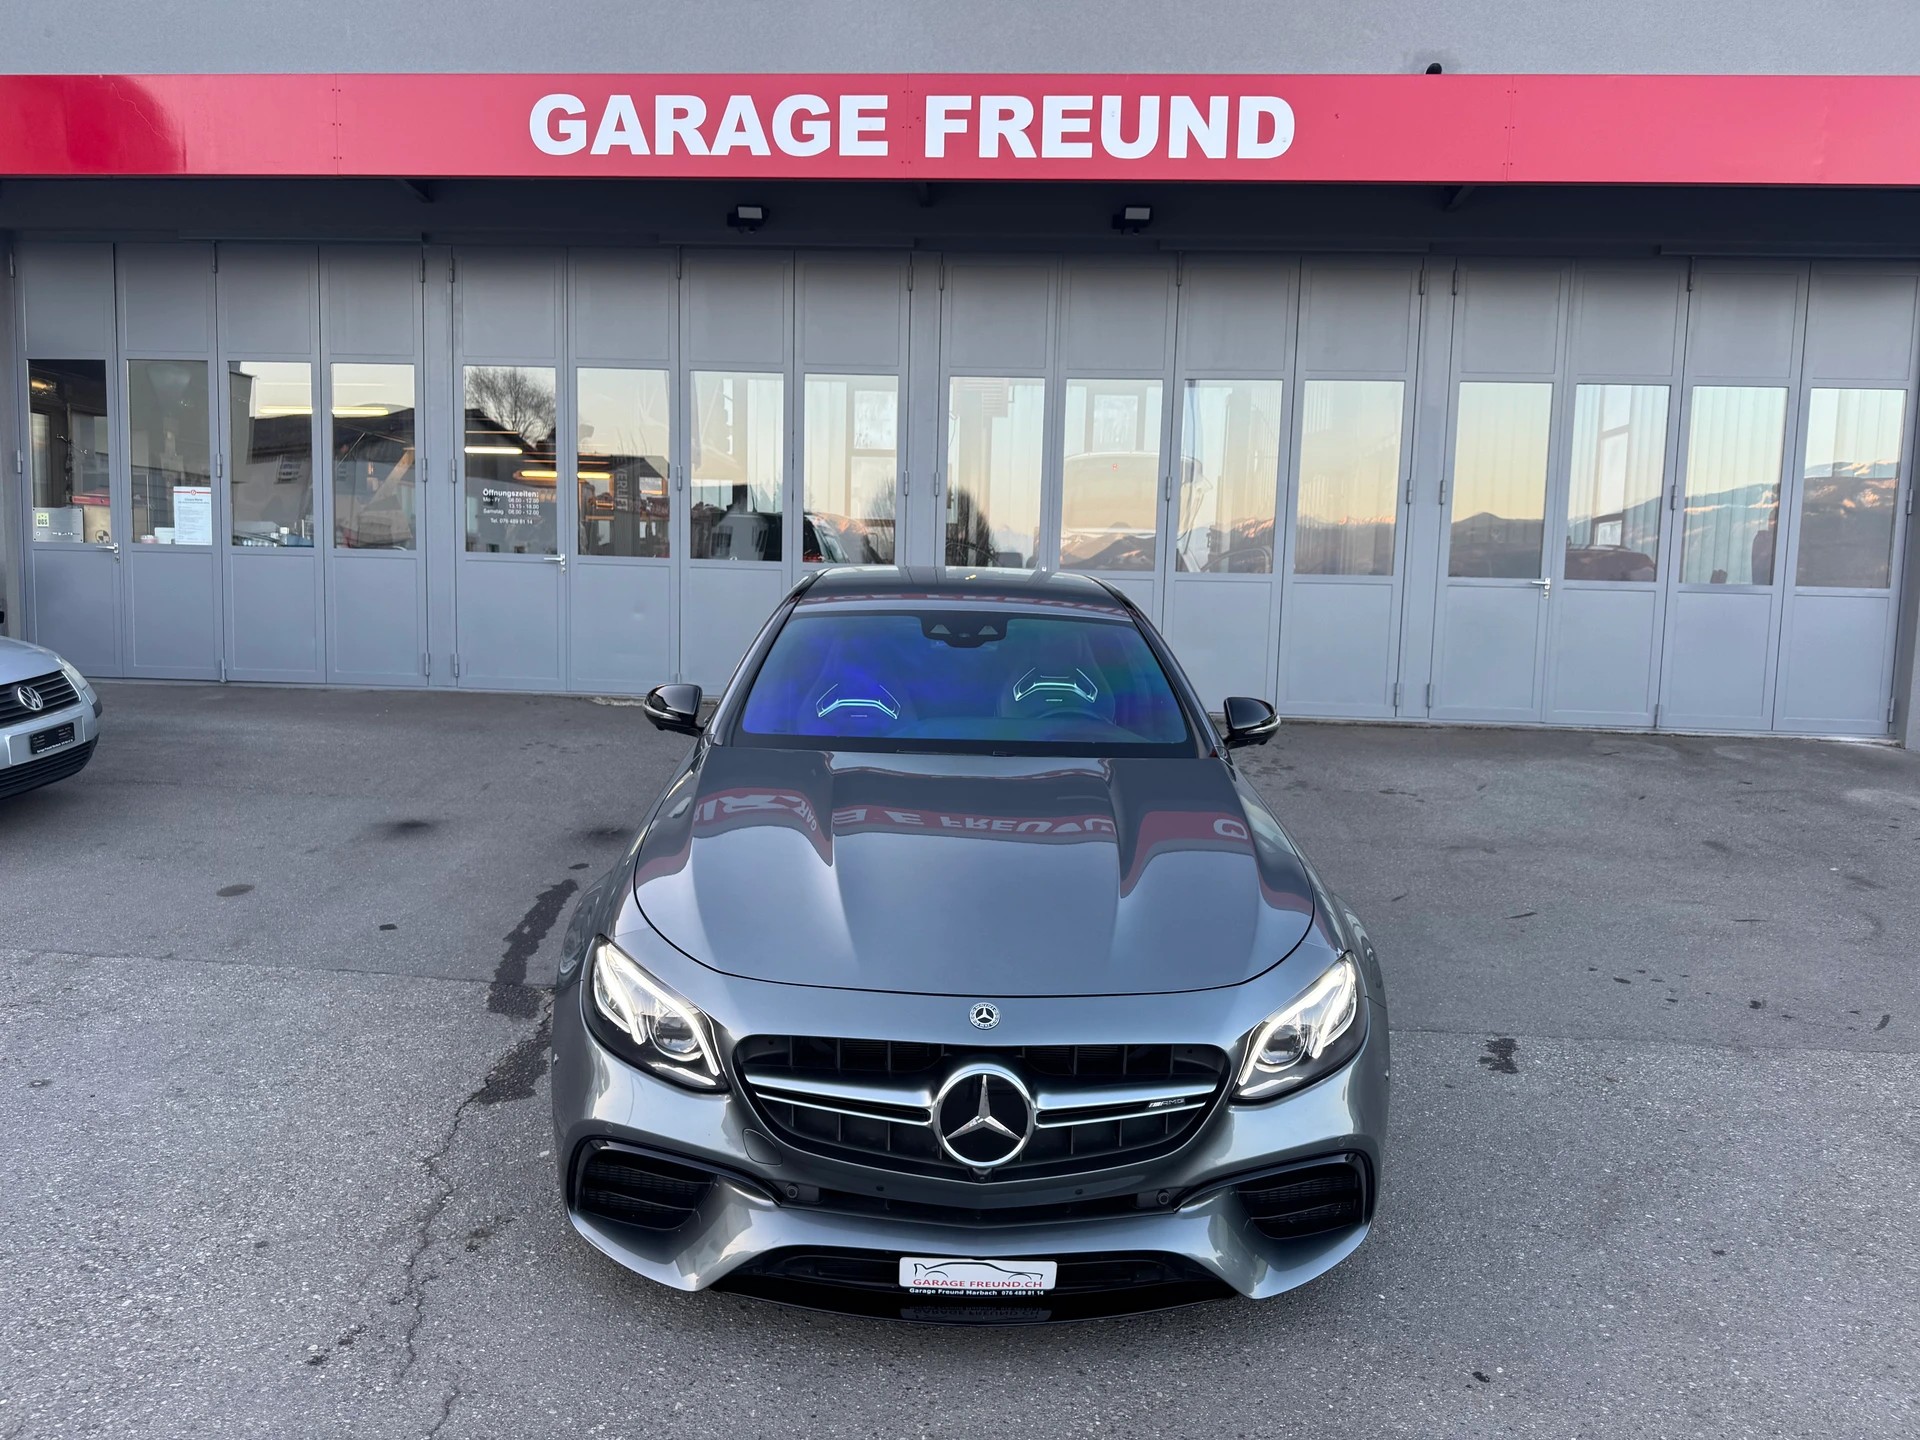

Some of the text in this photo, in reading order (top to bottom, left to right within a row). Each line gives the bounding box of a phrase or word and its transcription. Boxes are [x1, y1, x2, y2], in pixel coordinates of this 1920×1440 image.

[529, 93, 1295, 160] GARAGE FREUND
[483, 488, 539, 498] Öffnungszeiten:
[913, 1278, 1043, 1288] GARAGE FREUND.CH
[909, 1287, 936, 1295] Garage
